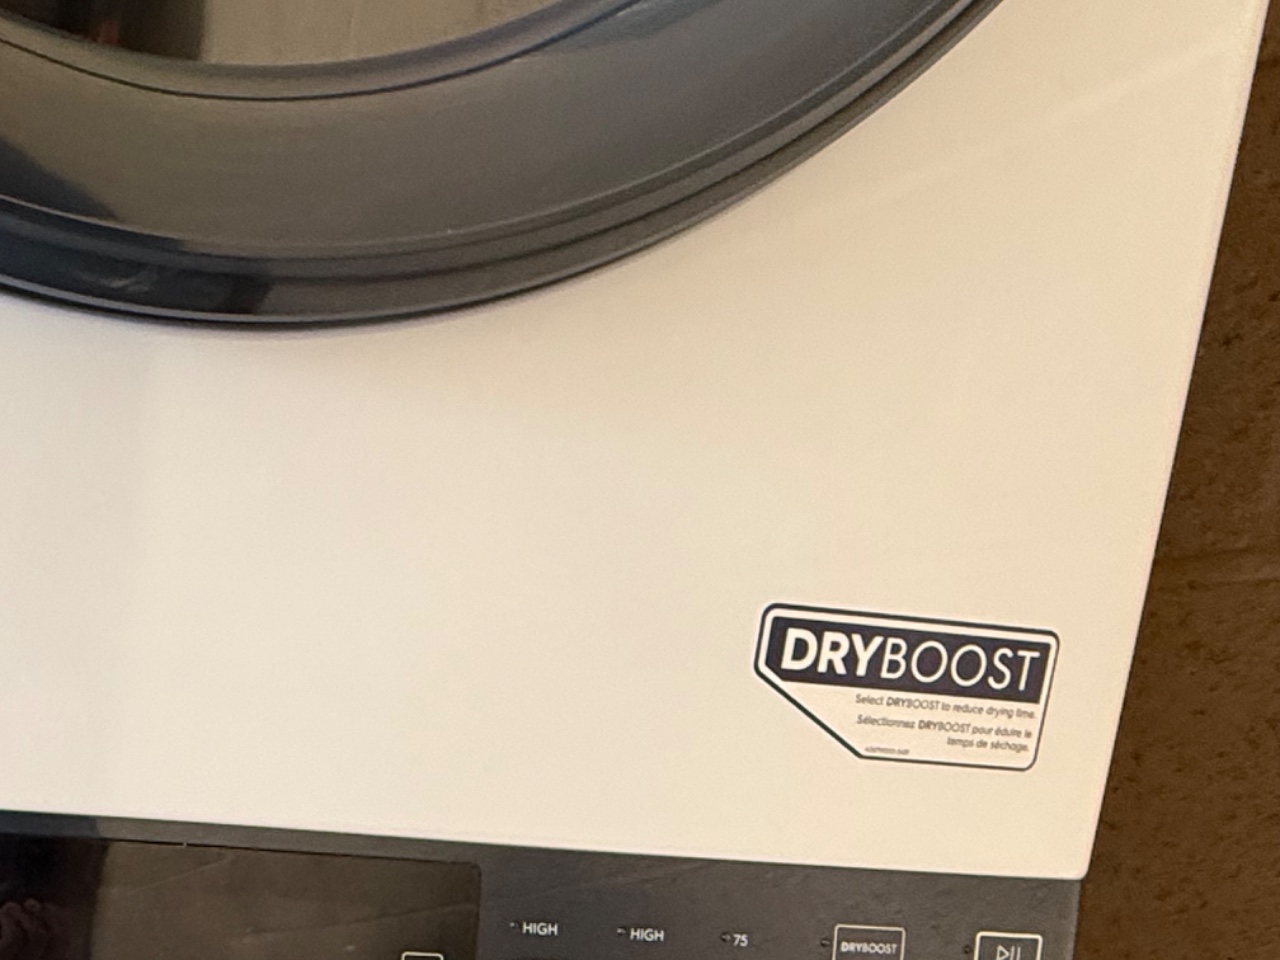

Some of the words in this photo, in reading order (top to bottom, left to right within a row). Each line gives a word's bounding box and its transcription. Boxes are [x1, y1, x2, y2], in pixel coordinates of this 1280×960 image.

[781, 627, 1041, 692] DRYBOOST
[856, 694, 884, 705] Select
[886, 697, 940, 710] DRYBOOST
[942, 702, 950, 711] to
[952, 704, 984, 714] reduce
[986, 707, 1014, 719] drying
[1016, 709, 1037, 719] time.
[522, 922, 558, 936] HIGH
[630, 928, 664, 942] HIGH
[733, 934, 748, 947] 75
[840, 941, 897, 954] DRYBOOST
